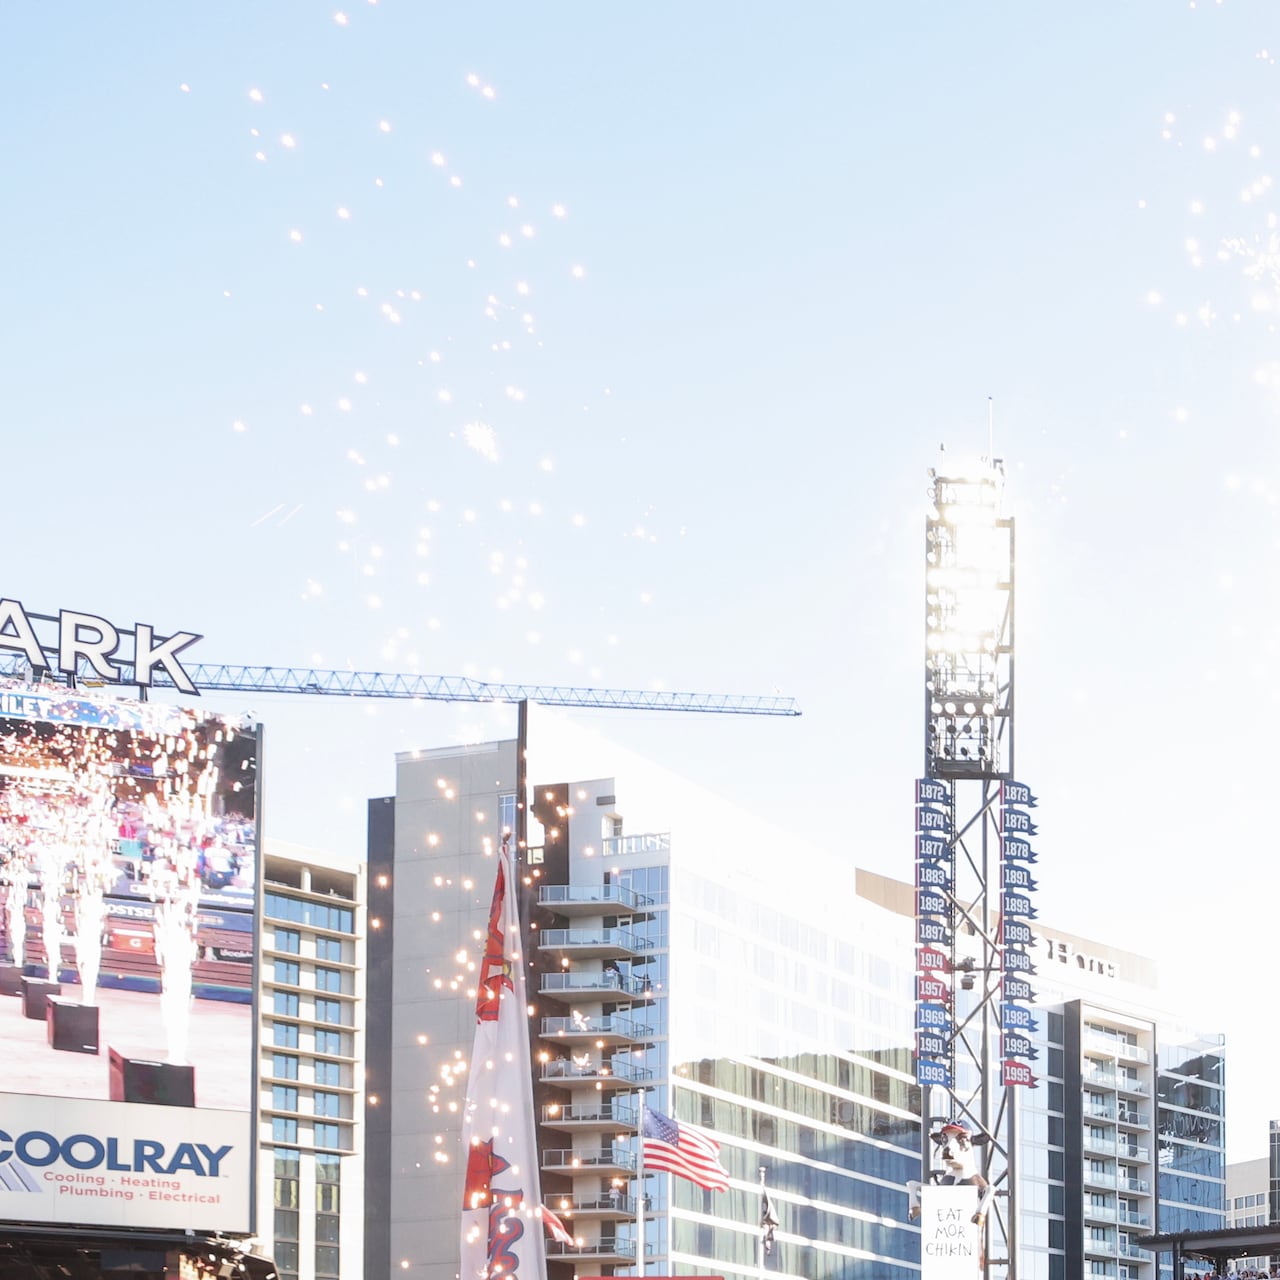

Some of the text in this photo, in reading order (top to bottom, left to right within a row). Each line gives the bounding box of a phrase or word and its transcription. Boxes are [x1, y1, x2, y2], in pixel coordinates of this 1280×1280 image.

[920, 784, 944, 799] 1872
[1004, 785, 1029, 801] 1873
[920, 811, 944, 827] 1874
[1004, 813, 1029, 829] 1875
[920, 840, 944, 856] 1877
[1004, 841, 1029, 857] 1878
[920, 868, 945, 885] 1883
[1004, 869, 1029, 885] 1891
[920, 896, 945, 912] 1892
[1004, 897, 1029, 913] 1893
[920, 924, 945, 941] 1897
[1004, 925, 1029, 941] 1898
[919, 952, 943, 969] 1914
[1004, 953, 1029, 969] 1948
[919, 980, 943, 996] 1957
[1004, 981, 1029, 997] 1958
[919, 1008, 945, 1025] 1969
[1004, 1009, 1029, 1025] 1982
[919, 1036, 944, 1053] 1991
[1004, 1037, 1029, 1053] 1992
[919, 1064, 945, 1081] 1993
[1004, 1065, 1030, 1083] 1995
[43, 1171, 181, 1191] Cooling Heating
[59, 1185, 221, 1204] Plumbing Electrical
[937, 1207, 964, 1222] EAT
[935, 1223, 966, 1239] MOR
[925, 1242, 973, 1257] CHIKIN
